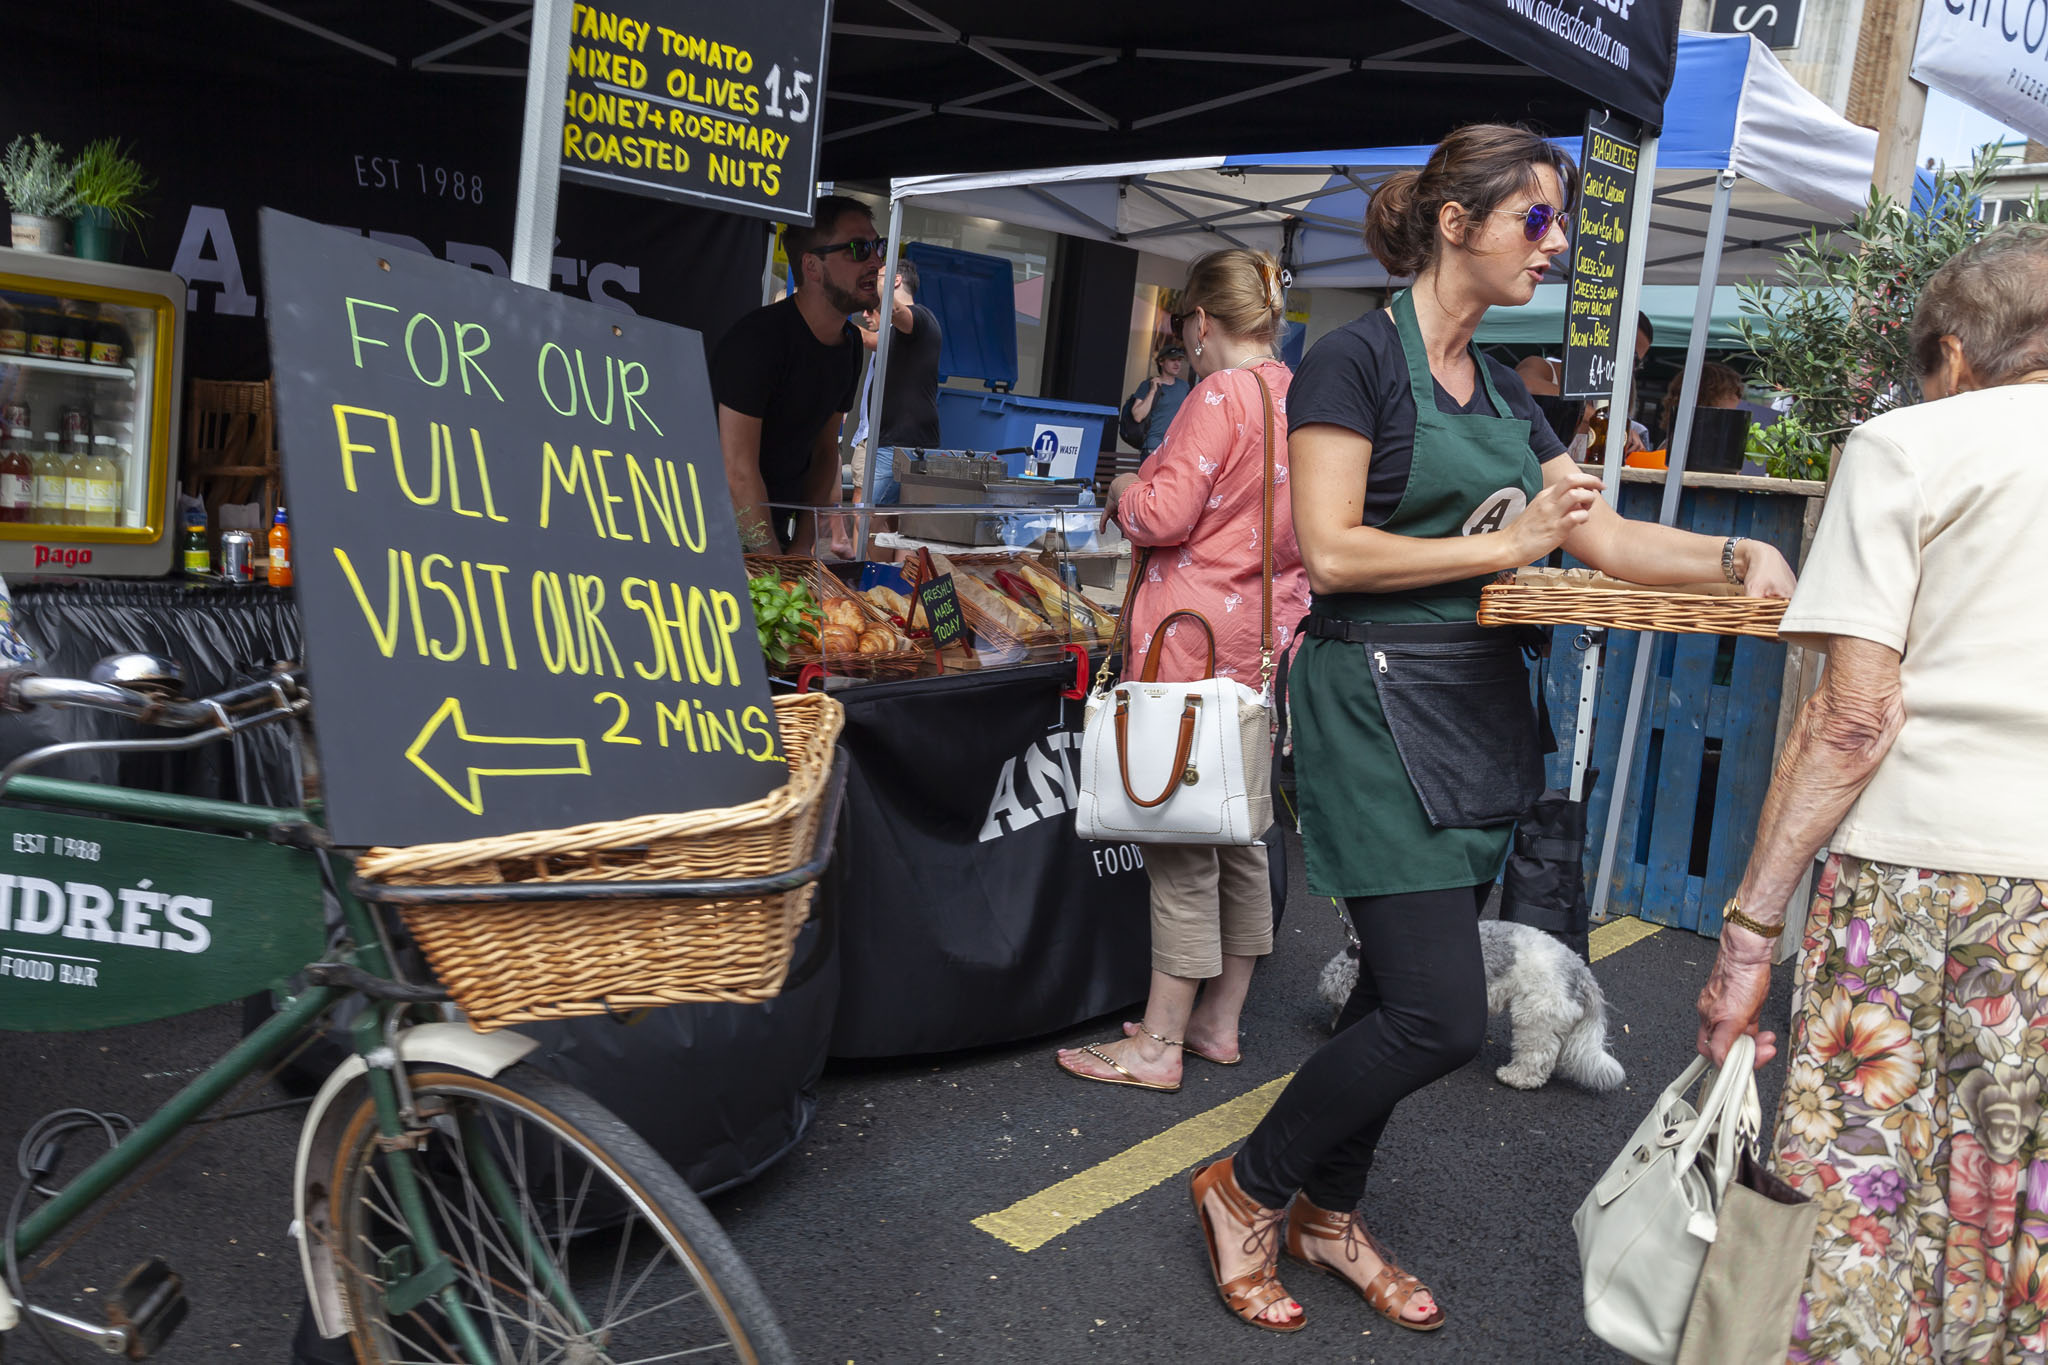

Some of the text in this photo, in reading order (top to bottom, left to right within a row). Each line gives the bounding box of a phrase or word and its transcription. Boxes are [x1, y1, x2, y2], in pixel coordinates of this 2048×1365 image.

[571, 3, 753, 74] TANGY TOMATO
[567, 45, 760, 116] MIXED OLIVES
[563, 123, 782, 196] ROASTED NUTS
[1592, 135, 1637, 170] BAGUETTES
[354, 155, 484, 205] EST 1988
[1591, 302, 1612, 316] BACON
[345, 296, 663, 437] FOR OUR
[1060, 445, 1079, 455] WASTE
[332, 404, 706, 553] FULL MENU
[922, 579, 953, 606] FRESHLY
[933, 598, 955, 622] MADE
[334, 547, 741, 687] VISIT OUR SHOP
[934, 614, 960, 641] TODAY
[593, 692, 642, 744] 2
[13, 832, 101, 861] EST 1988
[1093, 843, 1144, 878] FOOD
[1, 956, 98, 987] FOOD BAR
